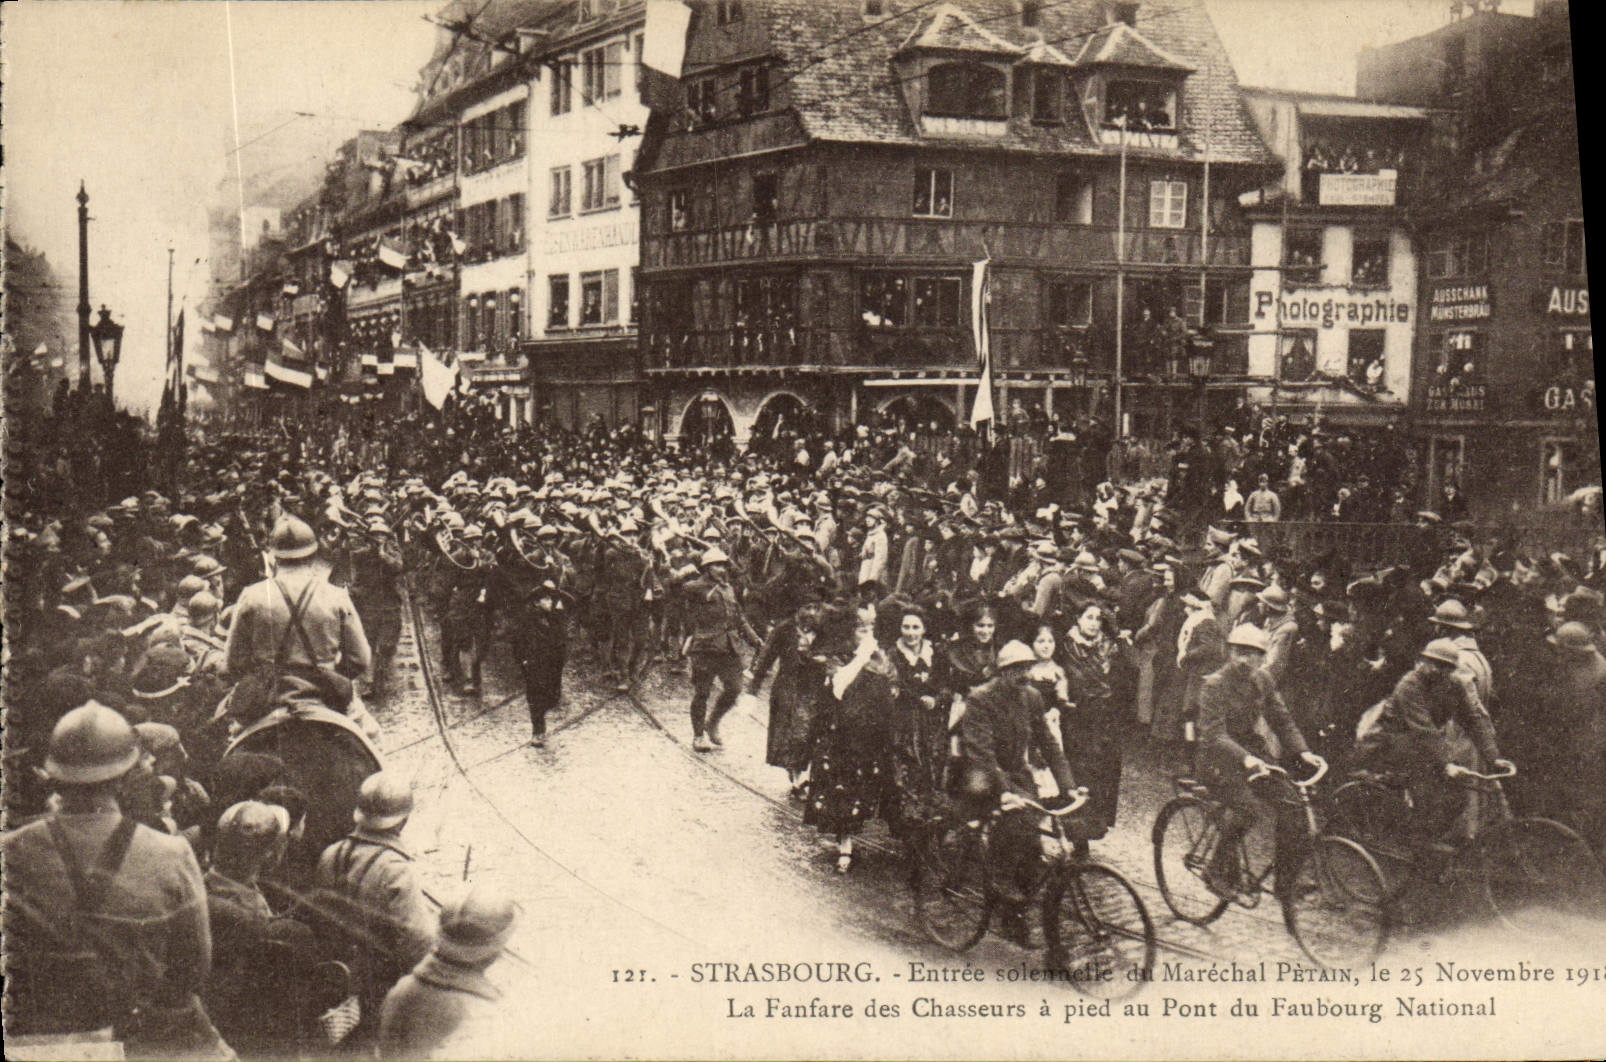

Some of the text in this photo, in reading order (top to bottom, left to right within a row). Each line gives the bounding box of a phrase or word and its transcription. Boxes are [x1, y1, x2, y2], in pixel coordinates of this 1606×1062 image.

[1432, 285, 1489, 303] AUSSCHANK
[1547, 286, 1590, 314] AUS
[1254, 290, 1409, 328] Photographie
